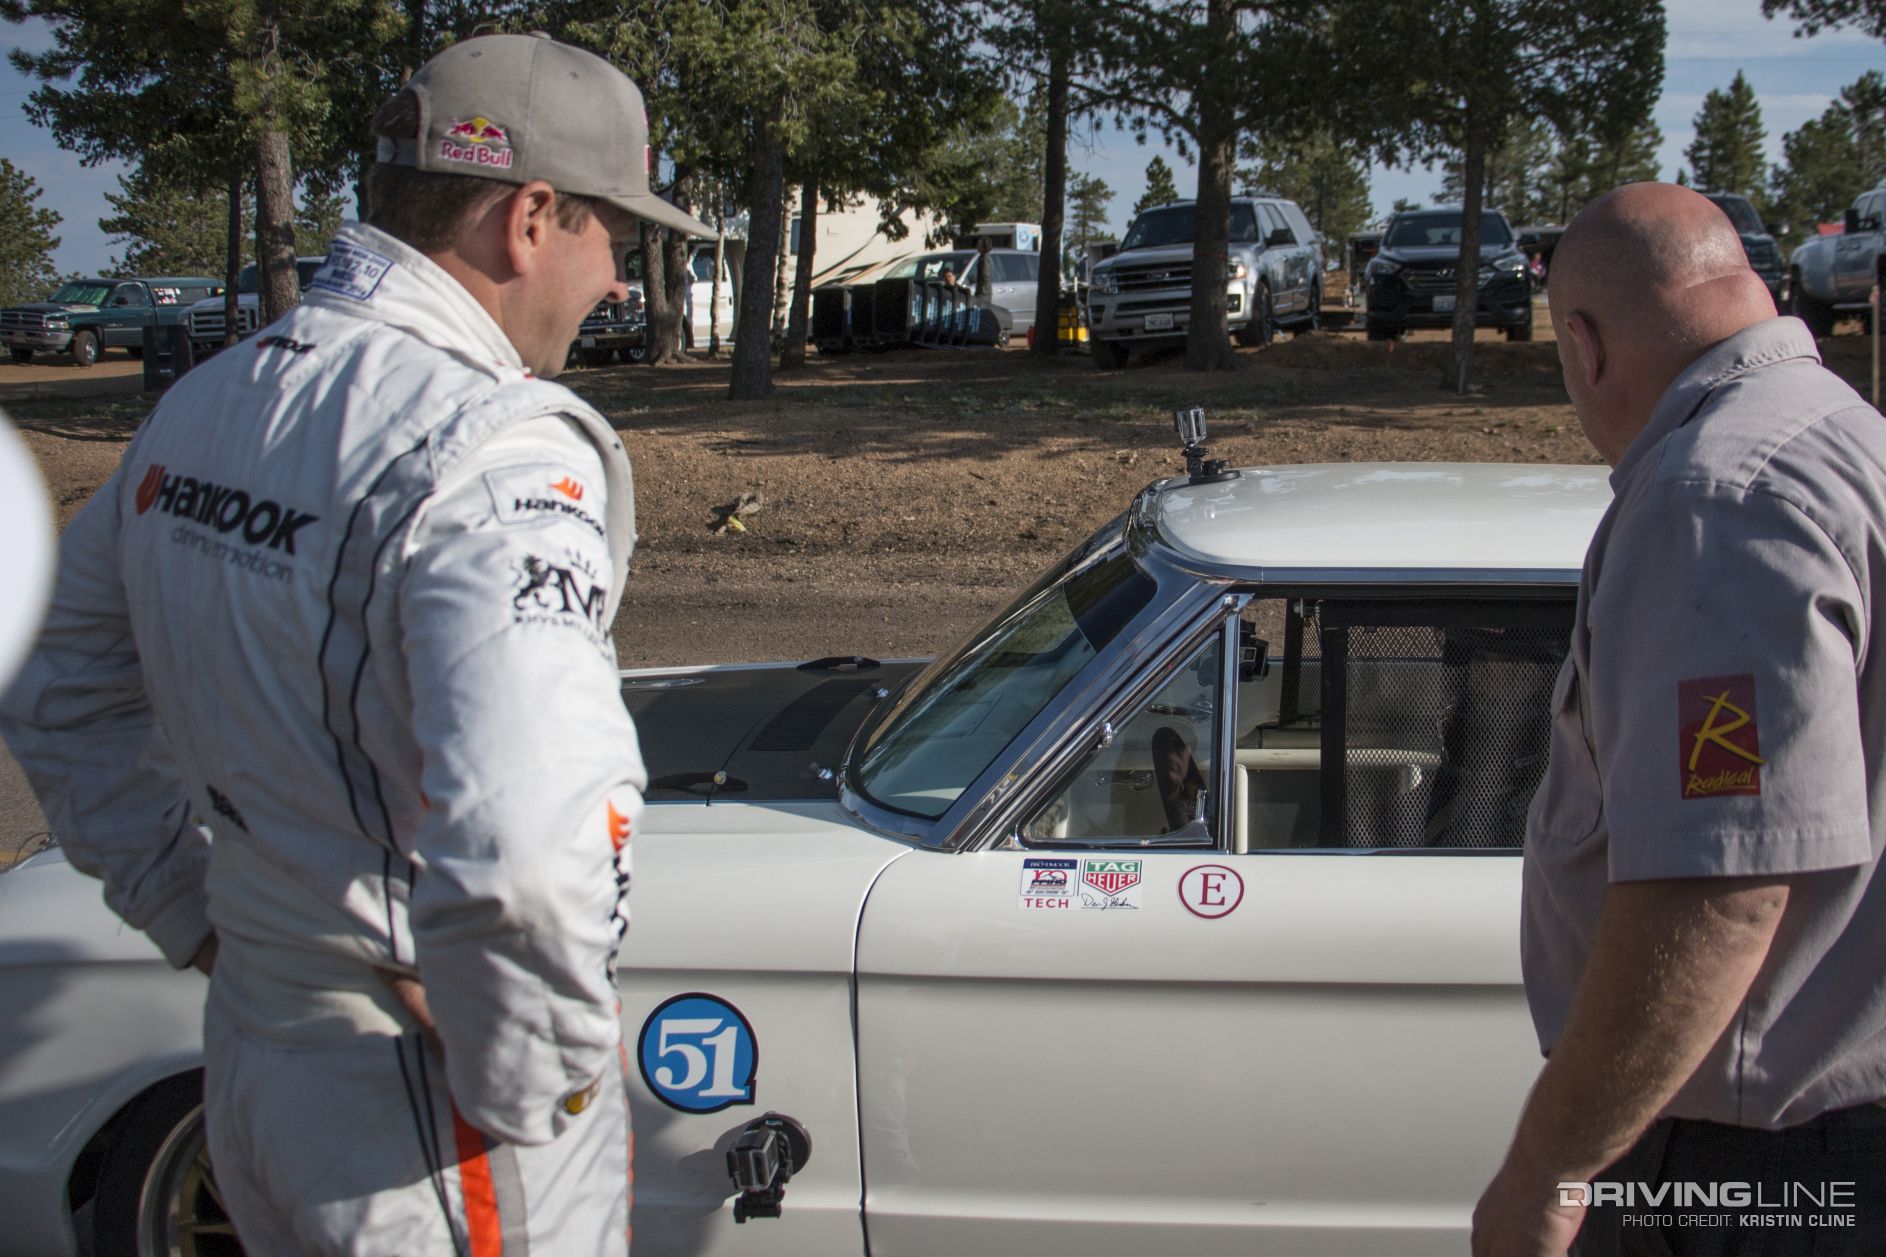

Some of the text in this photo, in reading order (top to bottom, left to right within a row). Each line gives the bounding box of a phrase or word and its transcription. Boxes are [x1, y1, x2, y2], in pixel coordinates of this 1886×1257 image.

[441, 140, 513, 168] Red Bull
[1685, 766, 1758, 797] Radical
[1090, 862, 1136, 872] TAG
[1087, 873, 1137, 894] HEUER
[1198, 873, 1226, 906] E
[1024, 898, 1069, 908] TECH
[655, 1018, 746, 1097] 51
